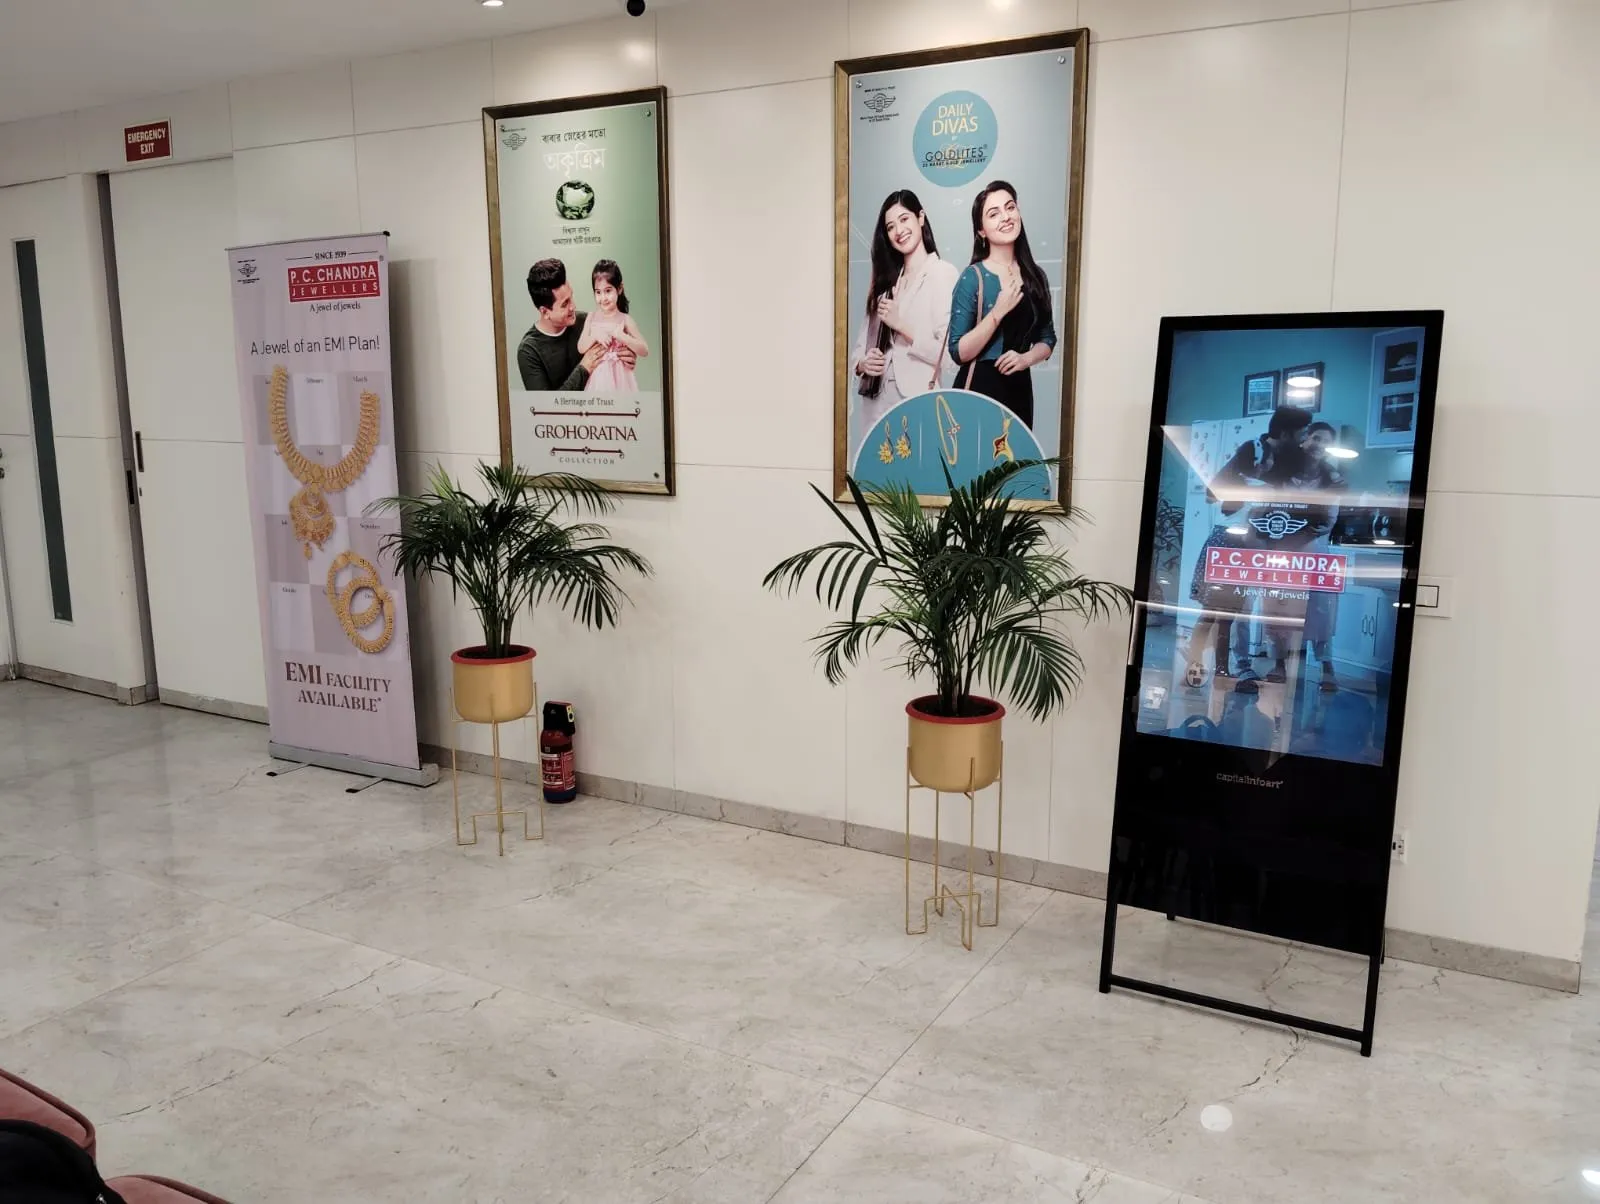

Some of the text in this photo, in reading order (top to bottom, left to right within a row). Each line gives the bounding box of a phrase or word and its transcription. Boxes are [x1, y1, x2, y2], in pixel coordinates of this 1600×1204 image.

[938, 102, 974, 118] DAILY
[932, 116, 978, 136] DIVAS
[127, 128, 166, 144] EMERGENCY
[140, 142, 155, 154] EXIT
[314, 252, 333, 260] SINCE
[290, 265, 377, 283] P. C. CHANDRA
[291, 282, 378, 297] JEWELLERS
[310, 301, 361, 313] A jewel of jewels
[250, 335, 380, 356] A Jewel of an EMI Plan!
[554, 397, 614, 406] A Heritage of Trust
[534, 424, 638, 441] GROHORATNA
[559, 457, 615, 465] COLLECTION
[1211, 551, 1341, 572] P. C. CHANDRA
[1210, 569, 1341, 586] JEWELLERS
[1233, 587, 1241, 595] A
[1242, 588, 1266, 598] jewel
[1279, 590, 1310, 600] jewels
[285, 661, 391, 693] EMI FACILITY
